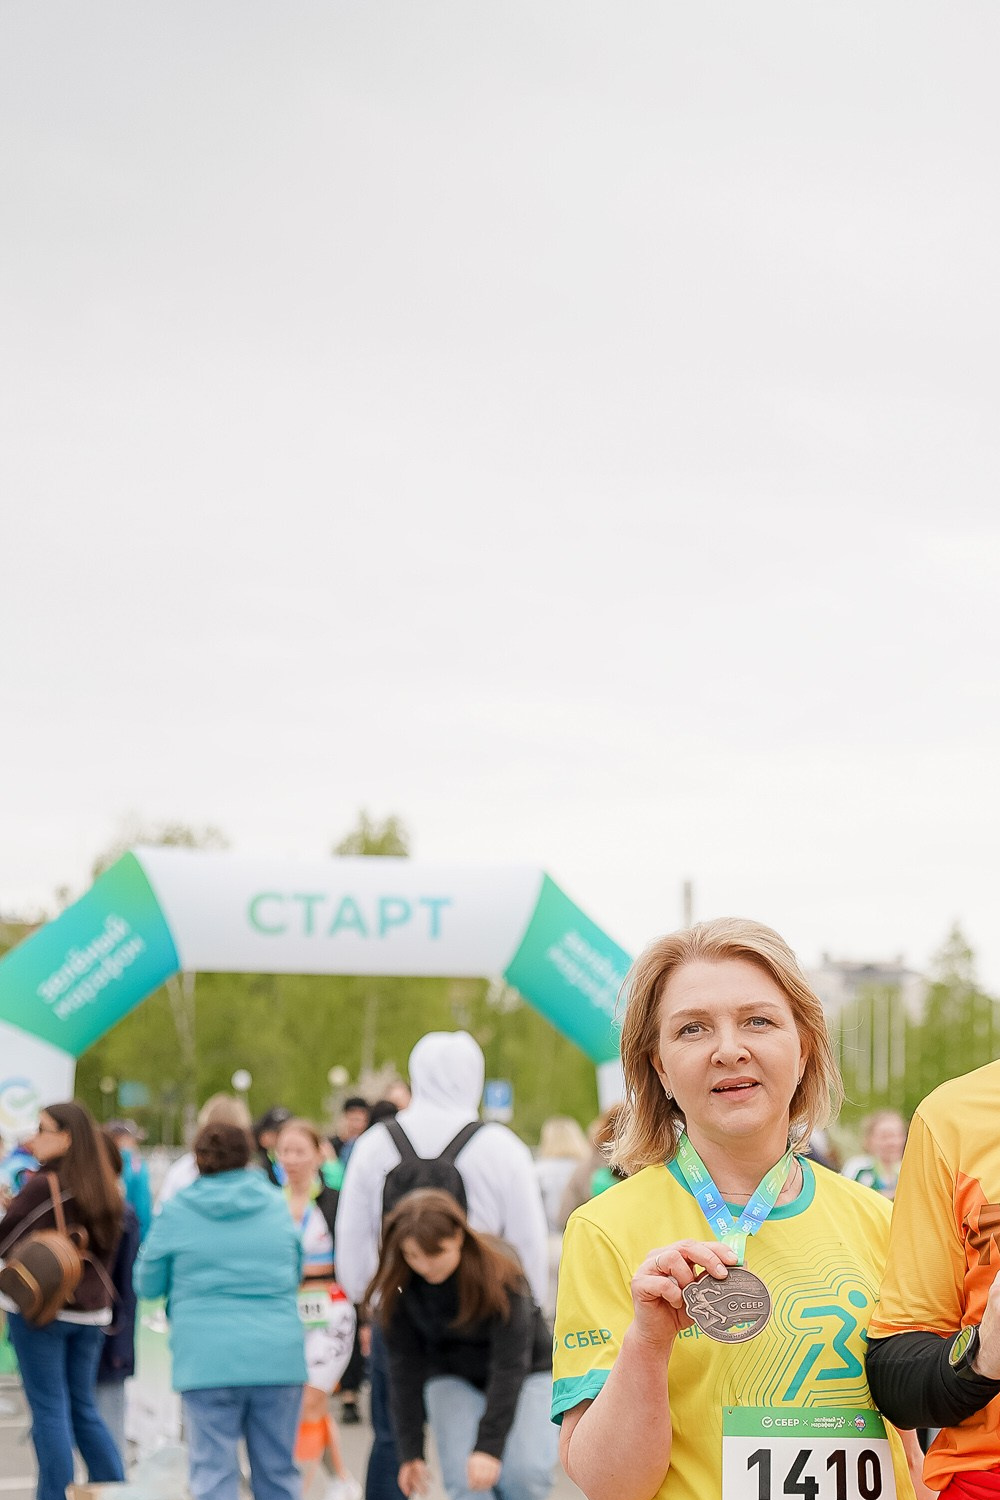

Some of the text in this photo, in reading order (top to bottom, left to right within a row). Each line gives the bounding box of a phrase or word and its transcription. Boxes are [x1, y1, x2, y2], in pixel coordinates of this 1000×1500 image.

[248, 891, 452, 939] СТАРТ
[740, 1301, 764, 1309] СБЕР
[563, 1328, 612, 1349] СБЕР
[775, 1418, 800, 1427] СБЕР
[747, 1448, 882, 1500] 1410
